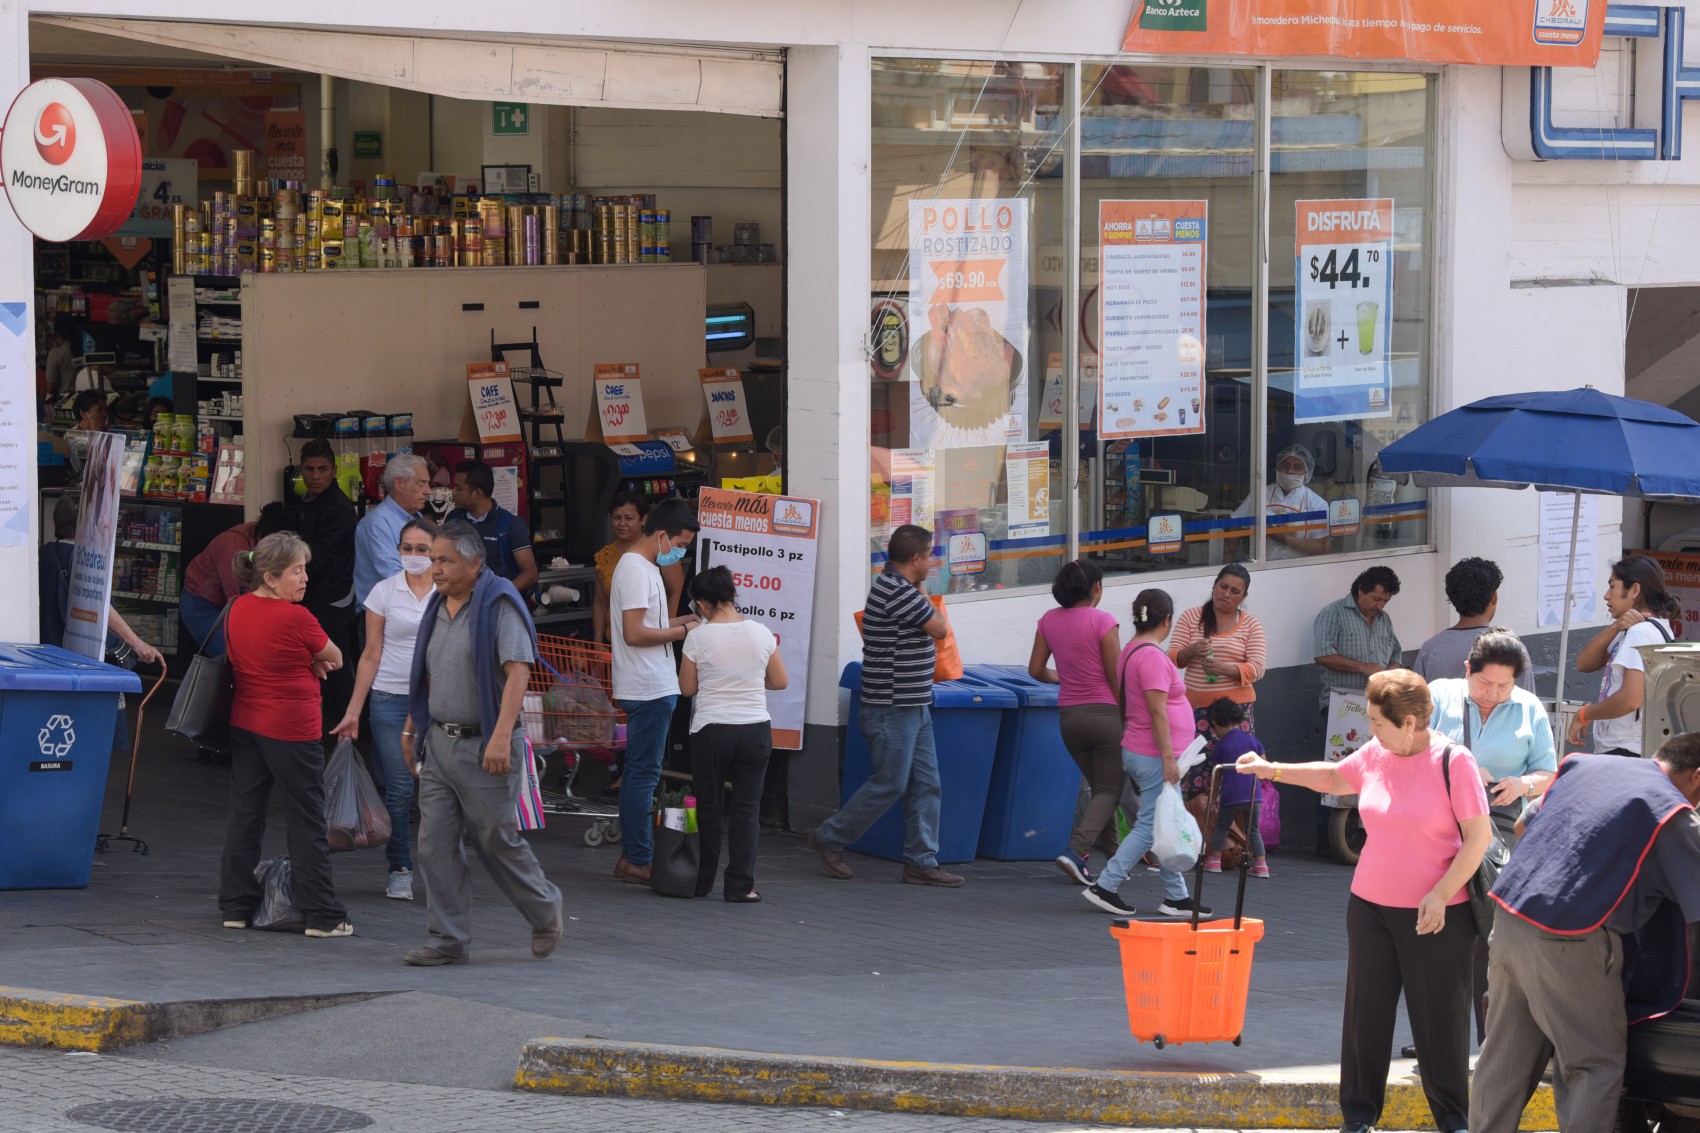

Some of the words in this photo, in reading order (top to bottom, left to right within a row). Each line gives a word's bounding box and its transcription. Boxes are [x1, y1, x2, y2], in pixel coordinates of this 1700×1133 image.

[1146, 6, 1167, 16] Banco
[1168, 8, 1200, 17] Azteca
[1362, 18, 1397, 28] tiempo
[1411, 22, 1431, 32] pago
[1434, 23, 1445, 32] de
[1448, 24, 1483, 34] servicios.
[268, 122, 303, 138] llevarte
[268, 154, 304, 167] cuesta
[268, 168, 304, 180] menos
[12, 170, 99, 195] MoneyGram
[140, 206, 173, 221] GRA
[924, 205, 1013, 233] POLLO
[1308, 210, 1380, 232] DISFRUTA
[1104, 222, 1132, 230] AHORRA
[1175, 222, 1200, 230] CUESTA
[1175, 230, 1200, 238] MENOS
[923, 236, 1012, 255] ROSTIZADO
[940, 271, 984, 289] $69.90
[481, 385, 499, 397] CAFE
[605, 384, 624, 395] CAFE
[640, 447, 670, 462] pepsi
[701, 496, 734, 511] llevarte
[734, 495, 769, 515] más
[701, 510, 732, 528] cuesta
[735, 515, 768, 532] menos
[713, 541, 773, 557] Tostipollo
[778, 549, 784, 558] 3
[789, 552, 803, 561] pz
[769, 608, 776, 617] 6
[780, 612, 795, 621] pz
